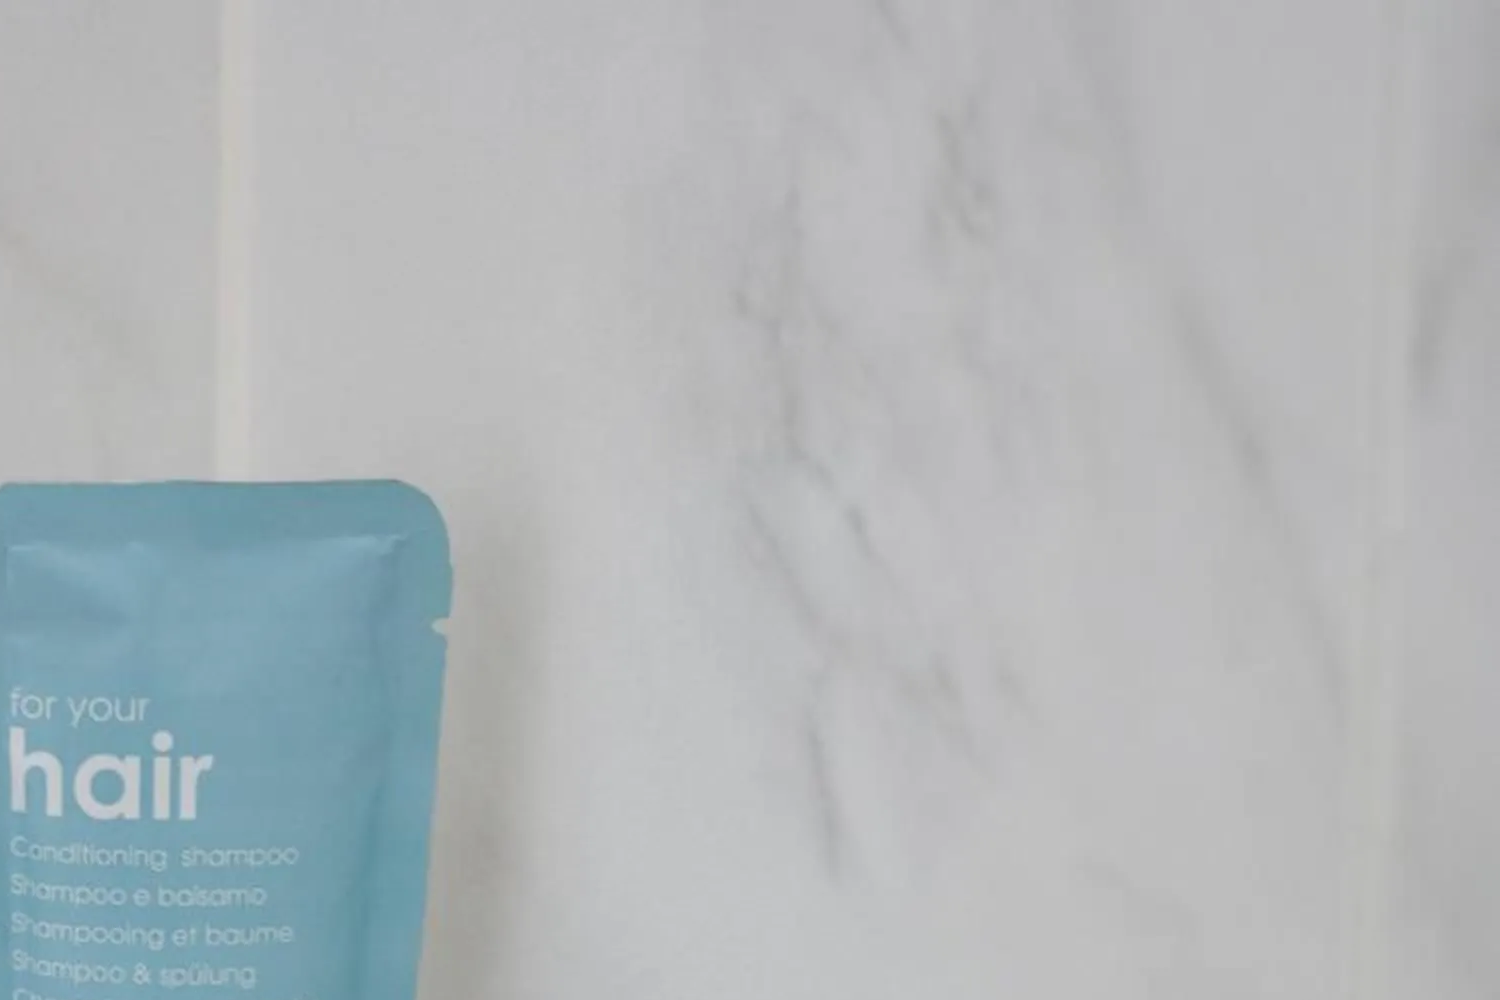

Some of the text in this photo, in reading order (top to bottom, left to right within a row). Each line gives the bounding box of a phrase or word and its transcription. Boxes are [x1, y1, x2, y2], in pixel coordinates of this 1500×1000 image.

[9, 685, 152, 729] for your
[8, 726, 215, 821] hair
[9, 835, 300, 872] Conditioning shampoo
[10, 873, 268, 908] Shampoo e balsamo
[10, 911, 295, 951] Shampooing et baume
[11, 949, 257, 989] Shampoo & spülung
